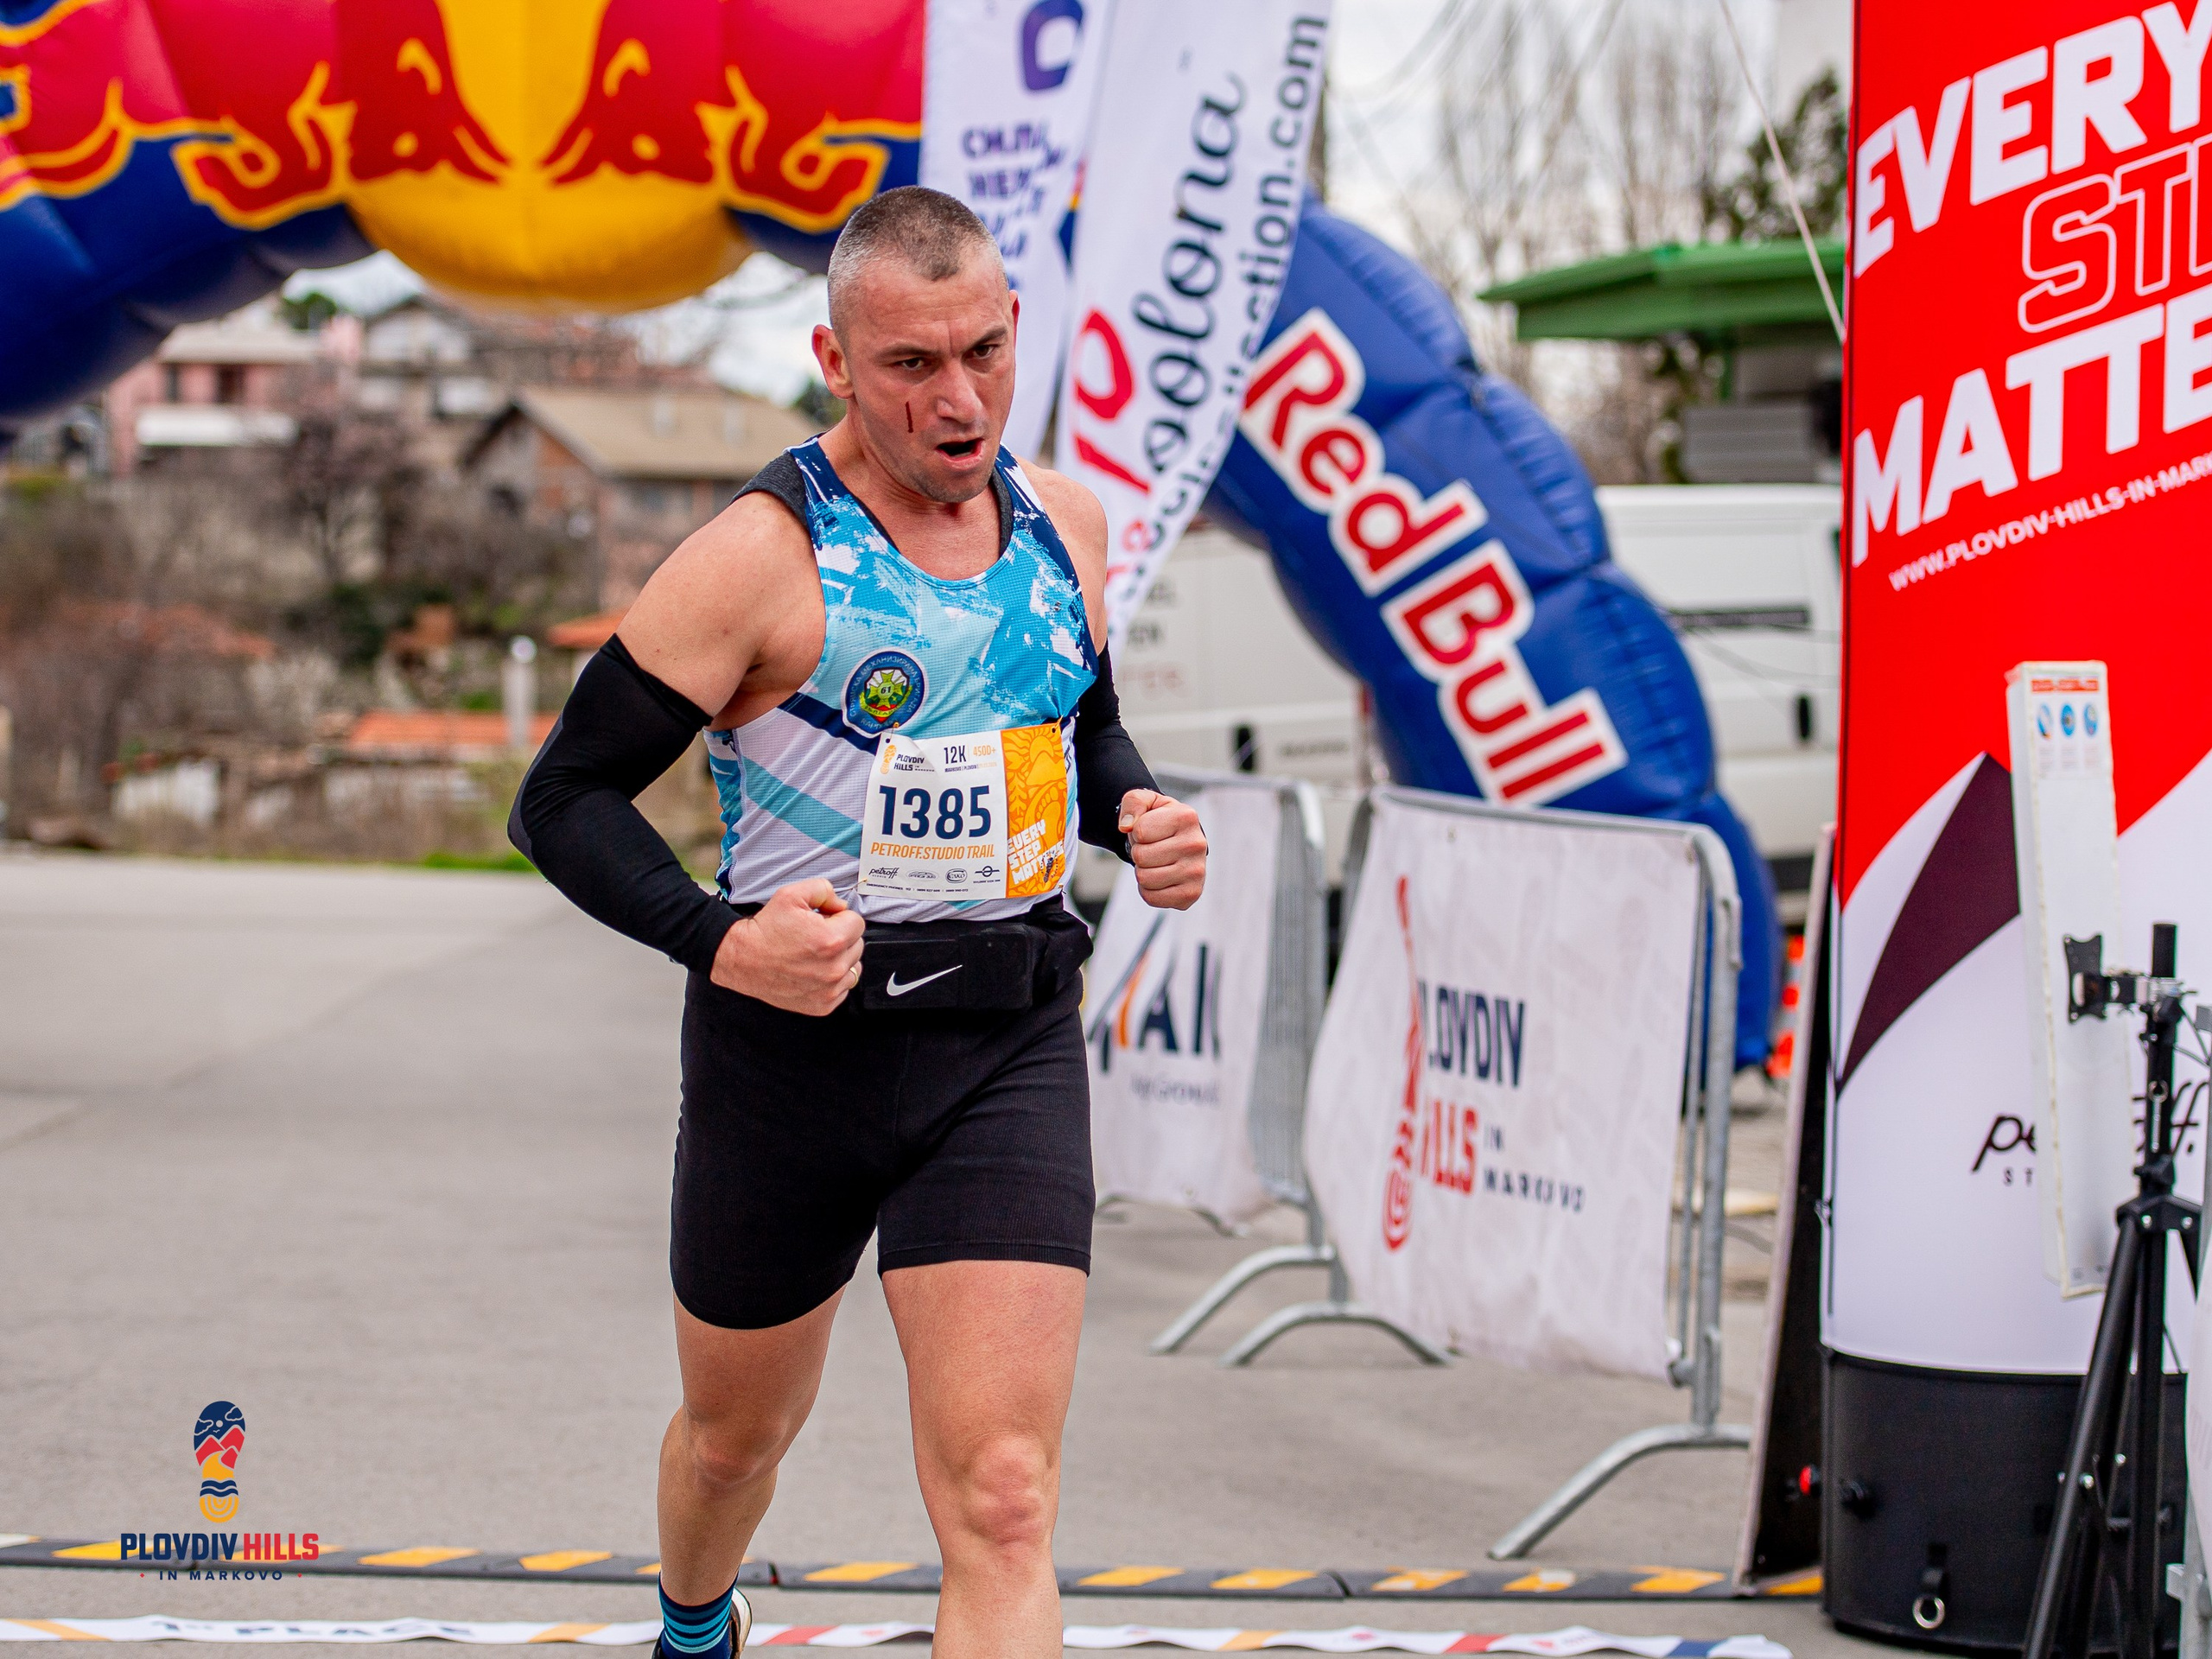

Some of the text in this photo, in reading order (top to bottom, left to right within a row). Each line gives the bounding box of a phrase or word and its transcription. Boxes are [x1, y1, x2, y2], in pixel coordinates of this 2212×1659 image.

[1244, 330, 1606, 800] Red Bull
[880, 686, 892, 695] 61
[896, 753, 925, 764] PLOVDIV
[944, 745, 967, 764] 12K
[893, 762, 913, 772] HILLS
[879, 785, 992, 840] 1385
[1007, 819, 1046, 855] EVERY
[870, 842, 995, 861] PETROFF.STUDIO TRAIL
[1008, 839, 1042, 870] STEP
